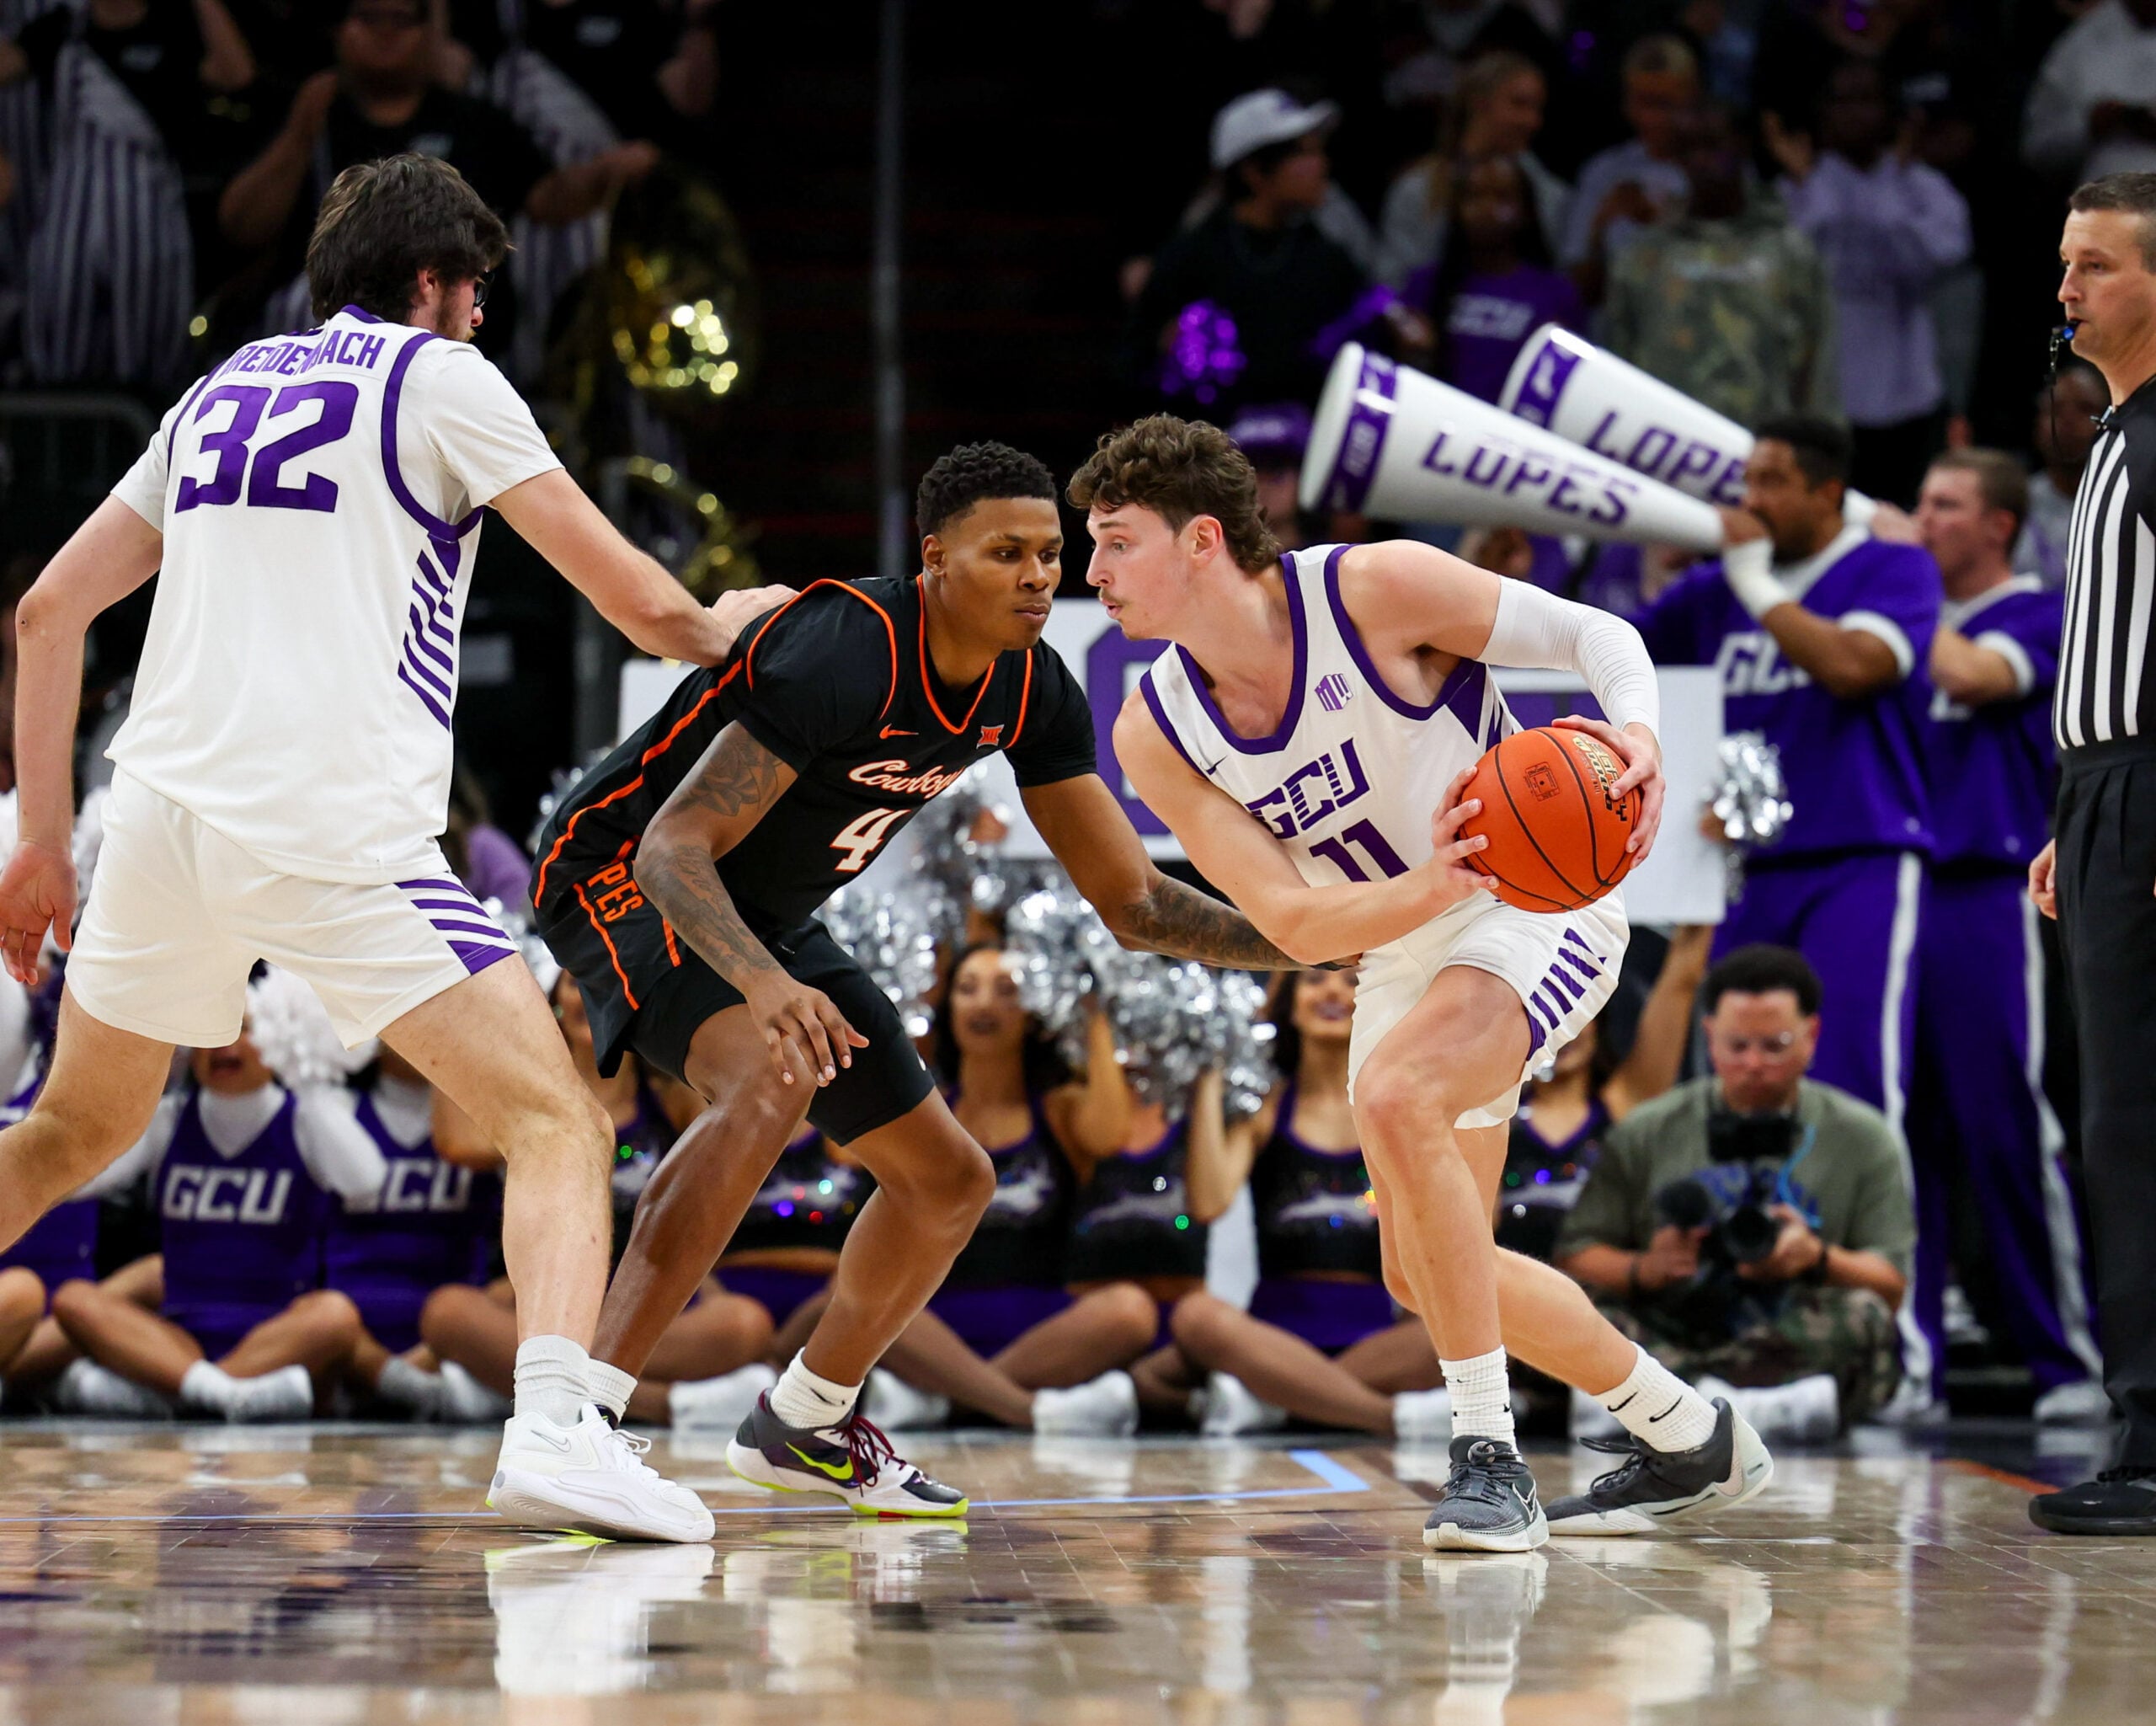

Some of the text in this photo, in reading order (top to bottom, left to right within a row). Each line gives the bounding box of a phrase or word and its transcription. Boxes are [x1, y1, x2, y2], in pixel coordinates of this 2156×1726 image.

[175, 381, 359, 514] 32
[1421, 430, 1639, 528] LOPES
[1584, 409, 1747, 507] LOPE
[848, 759, 966, 800] Cowboy
[1245, 737, 1371, 839] GCU
[829, 807, 912, 873] 4
[1308, 817, 1411, 883] 11
[163, 1163, 291, 1223] GCU
[345, 1157, 475, 1213] CU
